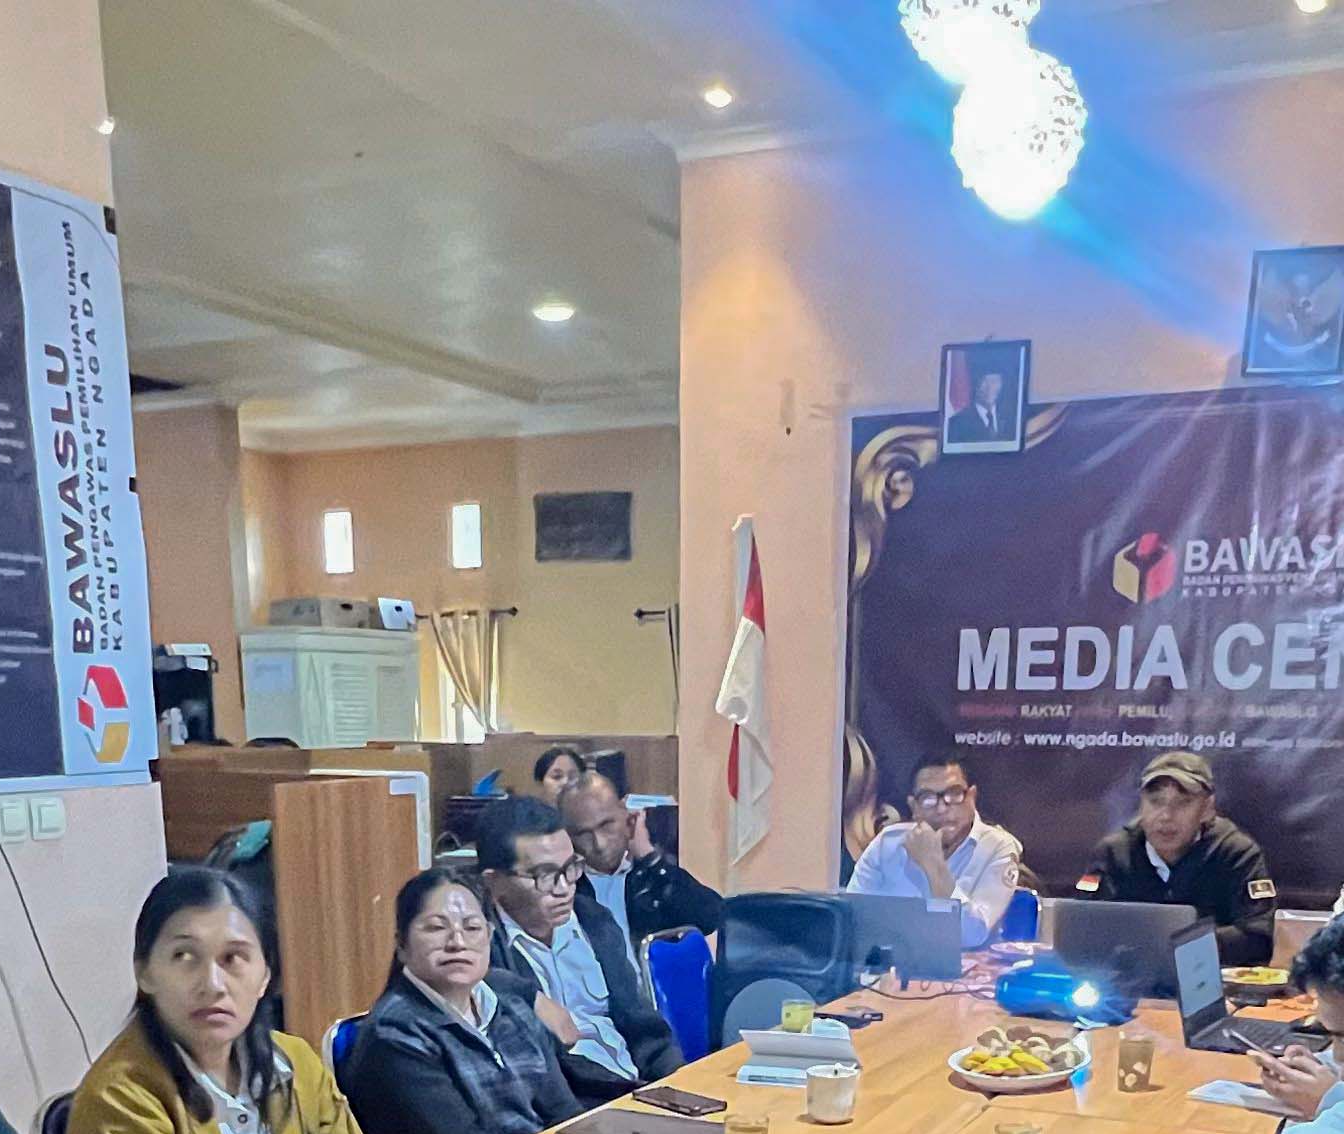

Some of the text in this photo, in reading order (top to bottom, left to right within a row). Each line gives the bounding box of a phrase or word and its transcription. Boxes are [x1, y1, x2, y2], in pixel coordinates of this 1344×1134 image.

[61, 220, 77, 296] UMUM
[69, 303, 92, 435] PEMILIHAN
[44, 342, 94, 654] BAWASLU
[79, 271, 123, 651] KABUPATEN NGADA
[95, 575, 109, 651] BADAN
[957, 624, 1188, 692] MEDIA
[954, 730, 1012, 746] website
[1022, 730, 1236, 751] www.ngada.bawaslu.go.id
[1020, 704, 1074, 719] RAKYAT
